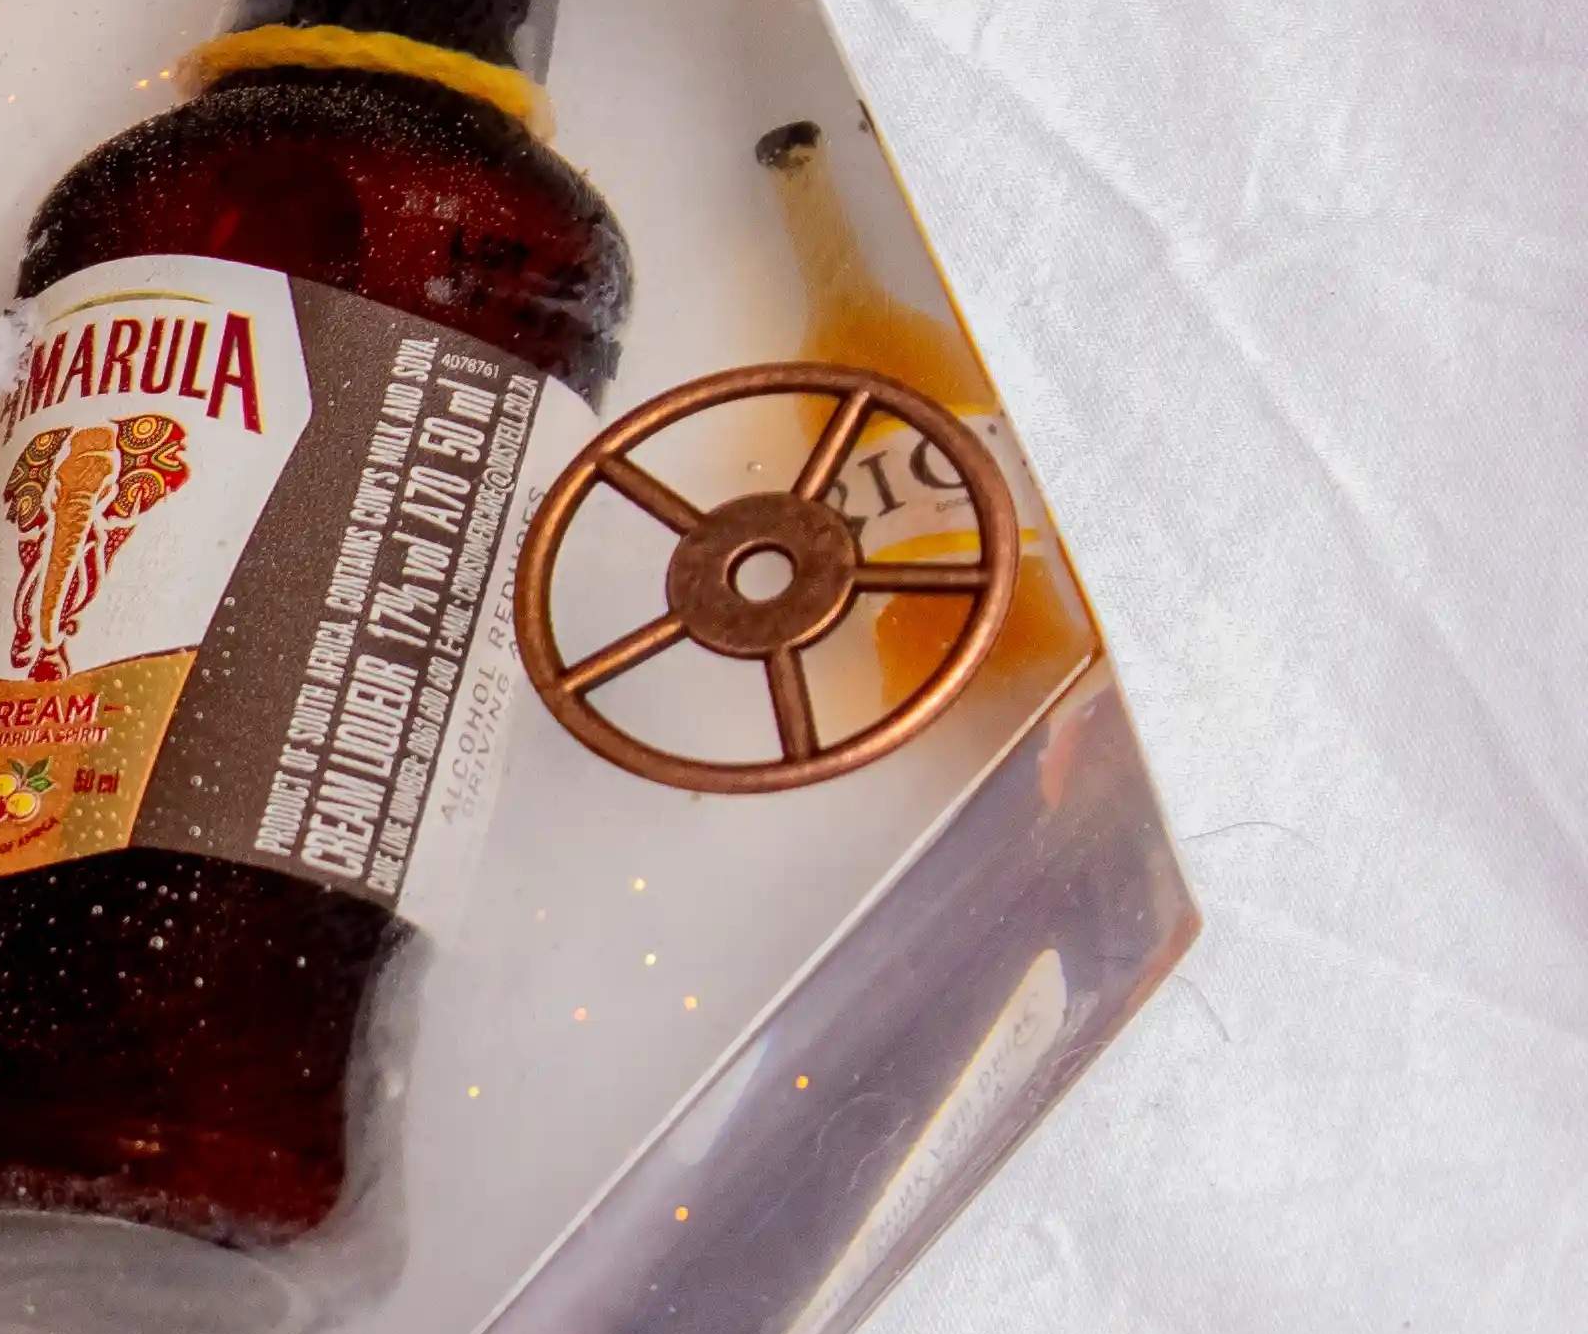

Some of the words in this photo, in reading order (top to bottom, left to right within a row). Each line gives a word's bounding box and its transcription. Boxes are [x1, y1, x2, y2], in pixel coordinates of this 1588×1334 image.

[390, 338, 440, 383] SOYA.
[380, 381, 423, 422] AND
[437, 376, 497, 424] ml
[366, 419, 413, 468] MILK
[418, 413, 486, 463] 50
[349, 465, 400, 527] COW'S
[401, 463, 472, 533] A70
[323, 524, 384, 614] CONTAINS
[391, 529, 453, 581] vol
[368, 580, 441, 648] 17%
[434, 596, 474, 655] E-MAIL:
[305, 619, 358, 685] AFRICA.
[425, 654, 459, 689] 600
[440, 665, 497, 824] ALCOHOL
[487, 485, 545, 649] REDES
[287, 683, 338, 745] SOUTH
[329, 650, 419, 778] LIQUEUR
[416, 685, 450, 722] 600
[280, 743, 320, 773] OF
[405, 716, 440, 757] 0861
[461, 671, 510, 818] DRIVING
[254, 769, 313, 855] PRODUCT
[299, 767, 387, 881] CREAM
[379, 817, 412, 856] LINE
[366, 849, 404, 894] CARE
